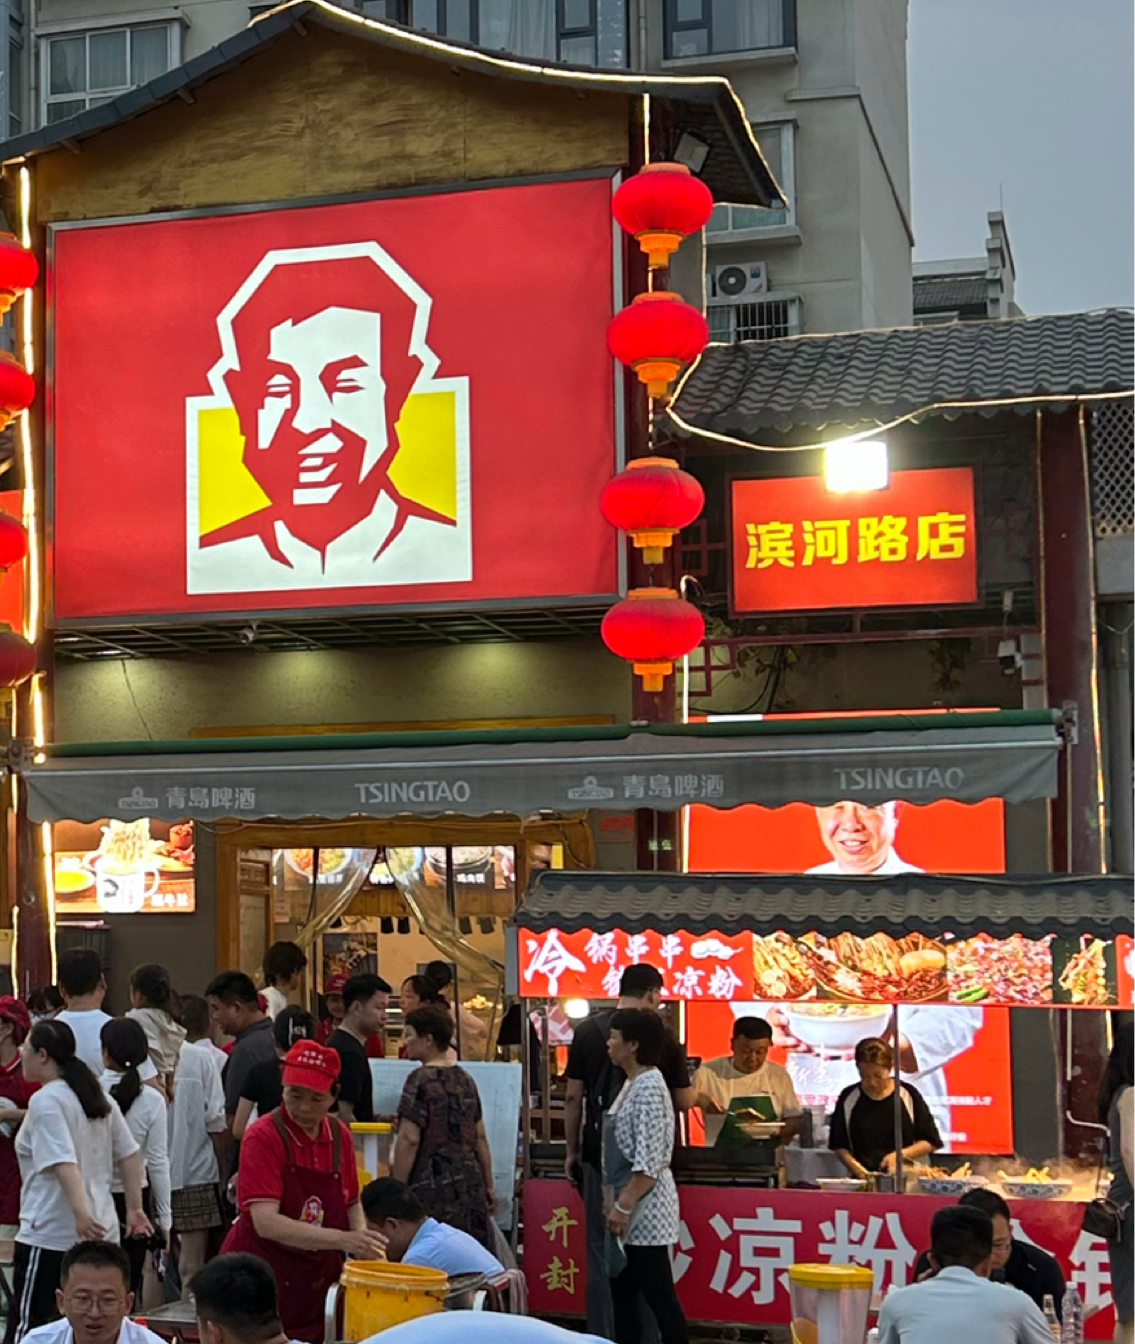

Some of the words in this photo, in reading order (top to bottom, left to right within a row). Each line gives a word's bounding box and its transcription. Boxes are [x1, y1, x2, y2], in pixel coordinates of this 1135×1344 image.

[745, 512, 967, 569] 滨河路店
[354, 780, 471, 804] TSINGTAO
[622, 773, 725, 799] 青岛啤酒
[833, 766, 966, 792] TSINGTAO
[165, 786, 256, 810] 青岛啤酒
[539, 1205, 580, 1295] 开封
